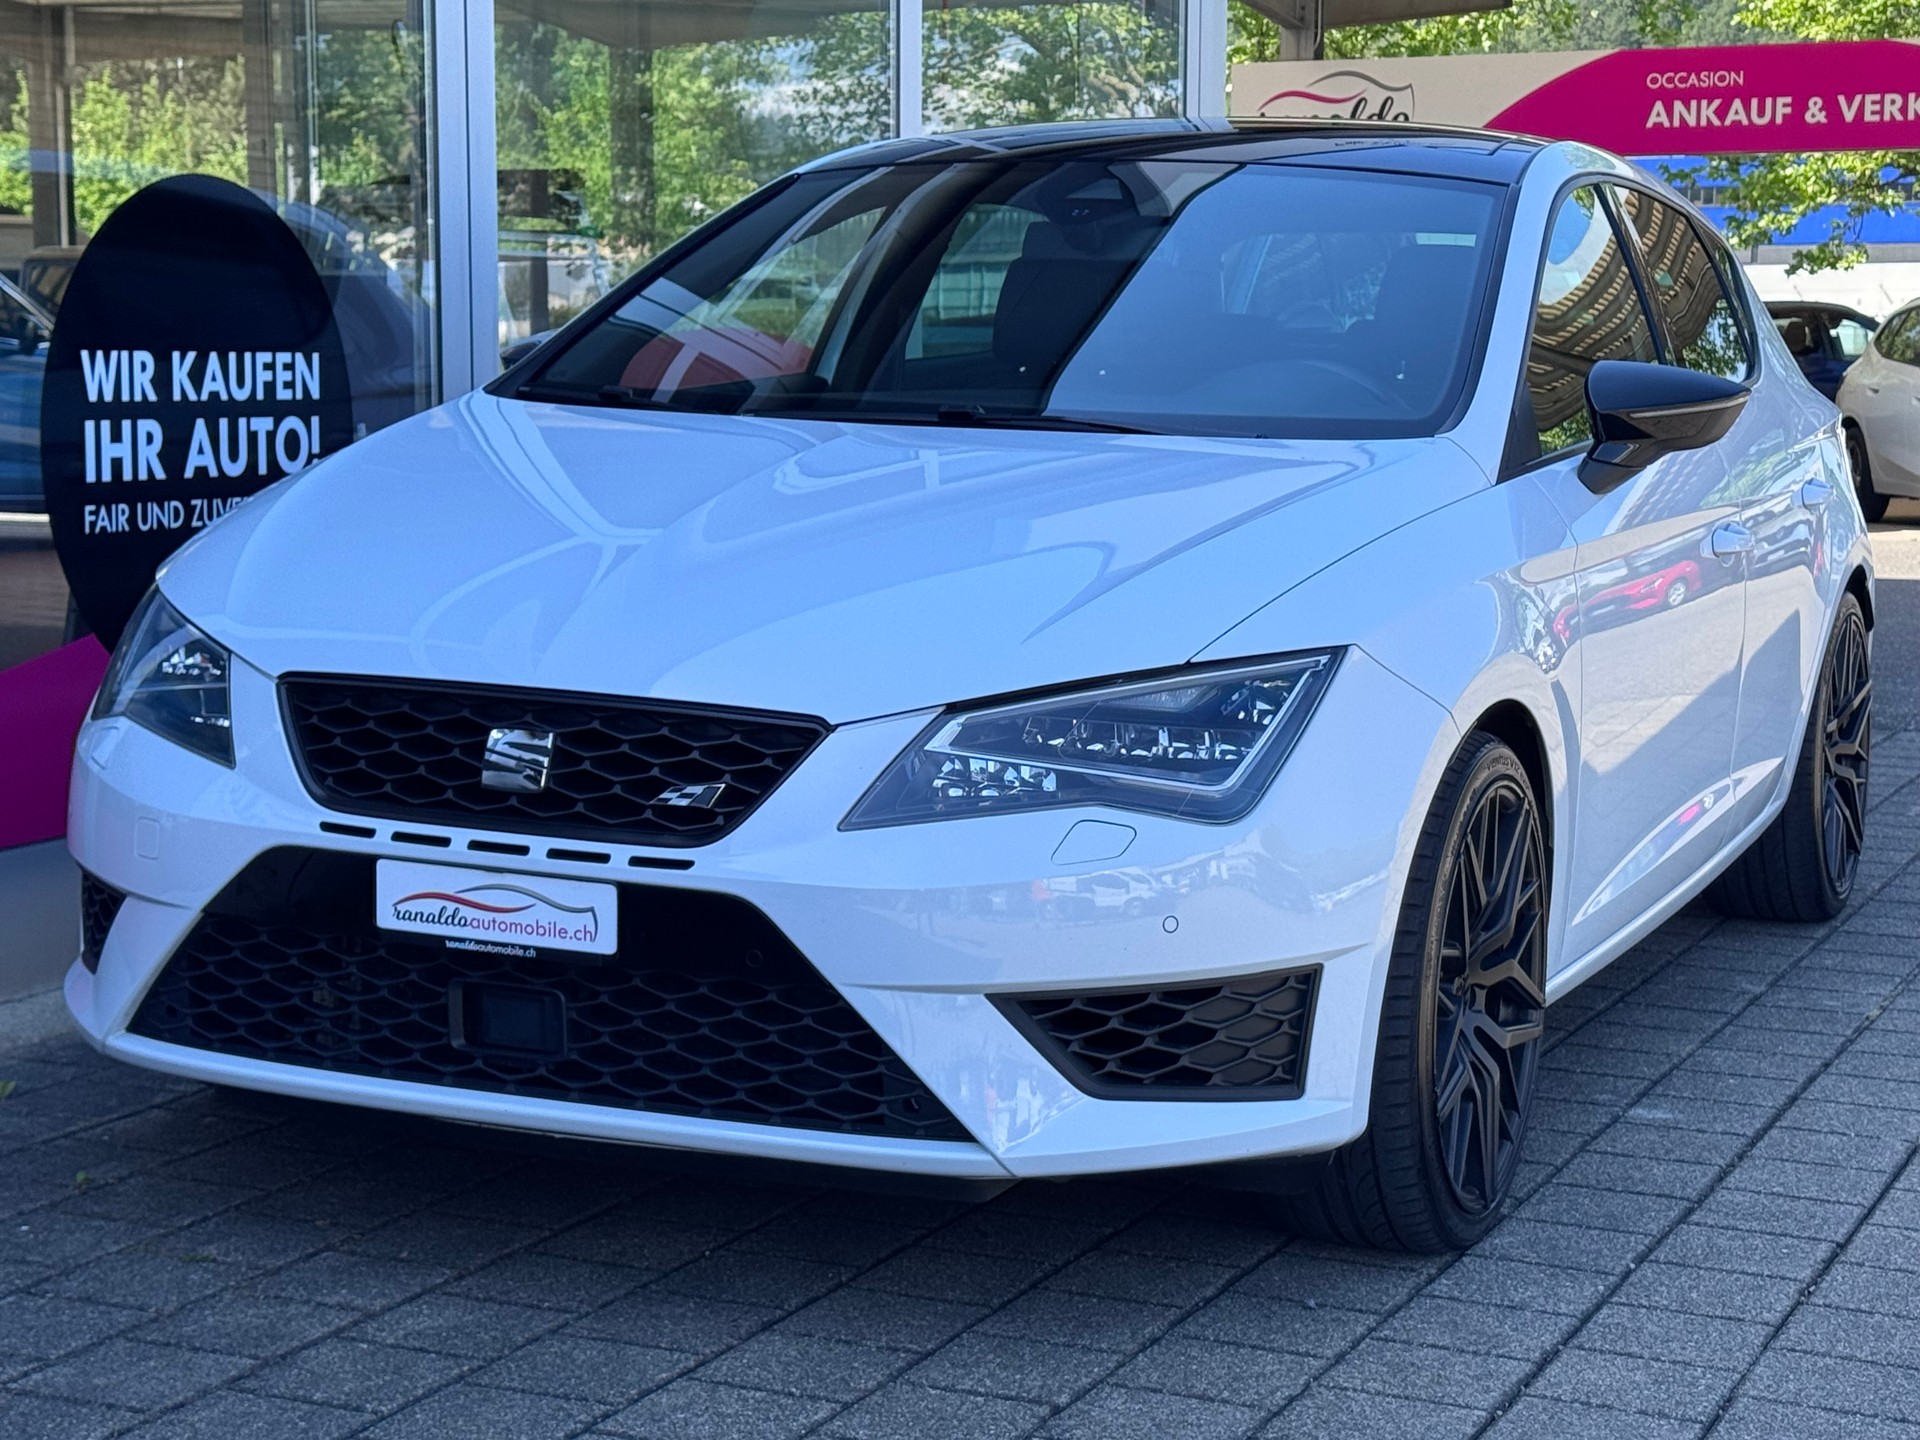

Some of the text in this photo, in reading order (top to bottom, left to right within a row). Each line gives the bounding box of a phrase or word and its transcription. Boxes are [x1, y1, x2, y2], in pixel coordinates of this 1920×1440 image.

[1646, 71, 1744, 89] OCCASION
[1645, 96, 1793, 128] ANKAUF
[1804, 97, 1828, 124] &
[80, 350, 320, 402] WIR KAUFEN
[84, 415, 321, 483] IHR AUTO!
[84, 503, 131, 535] FAIR
[137, 501, 185, 531] UND
[392, 905, 593, 942] ranaldoautomobile.ch
